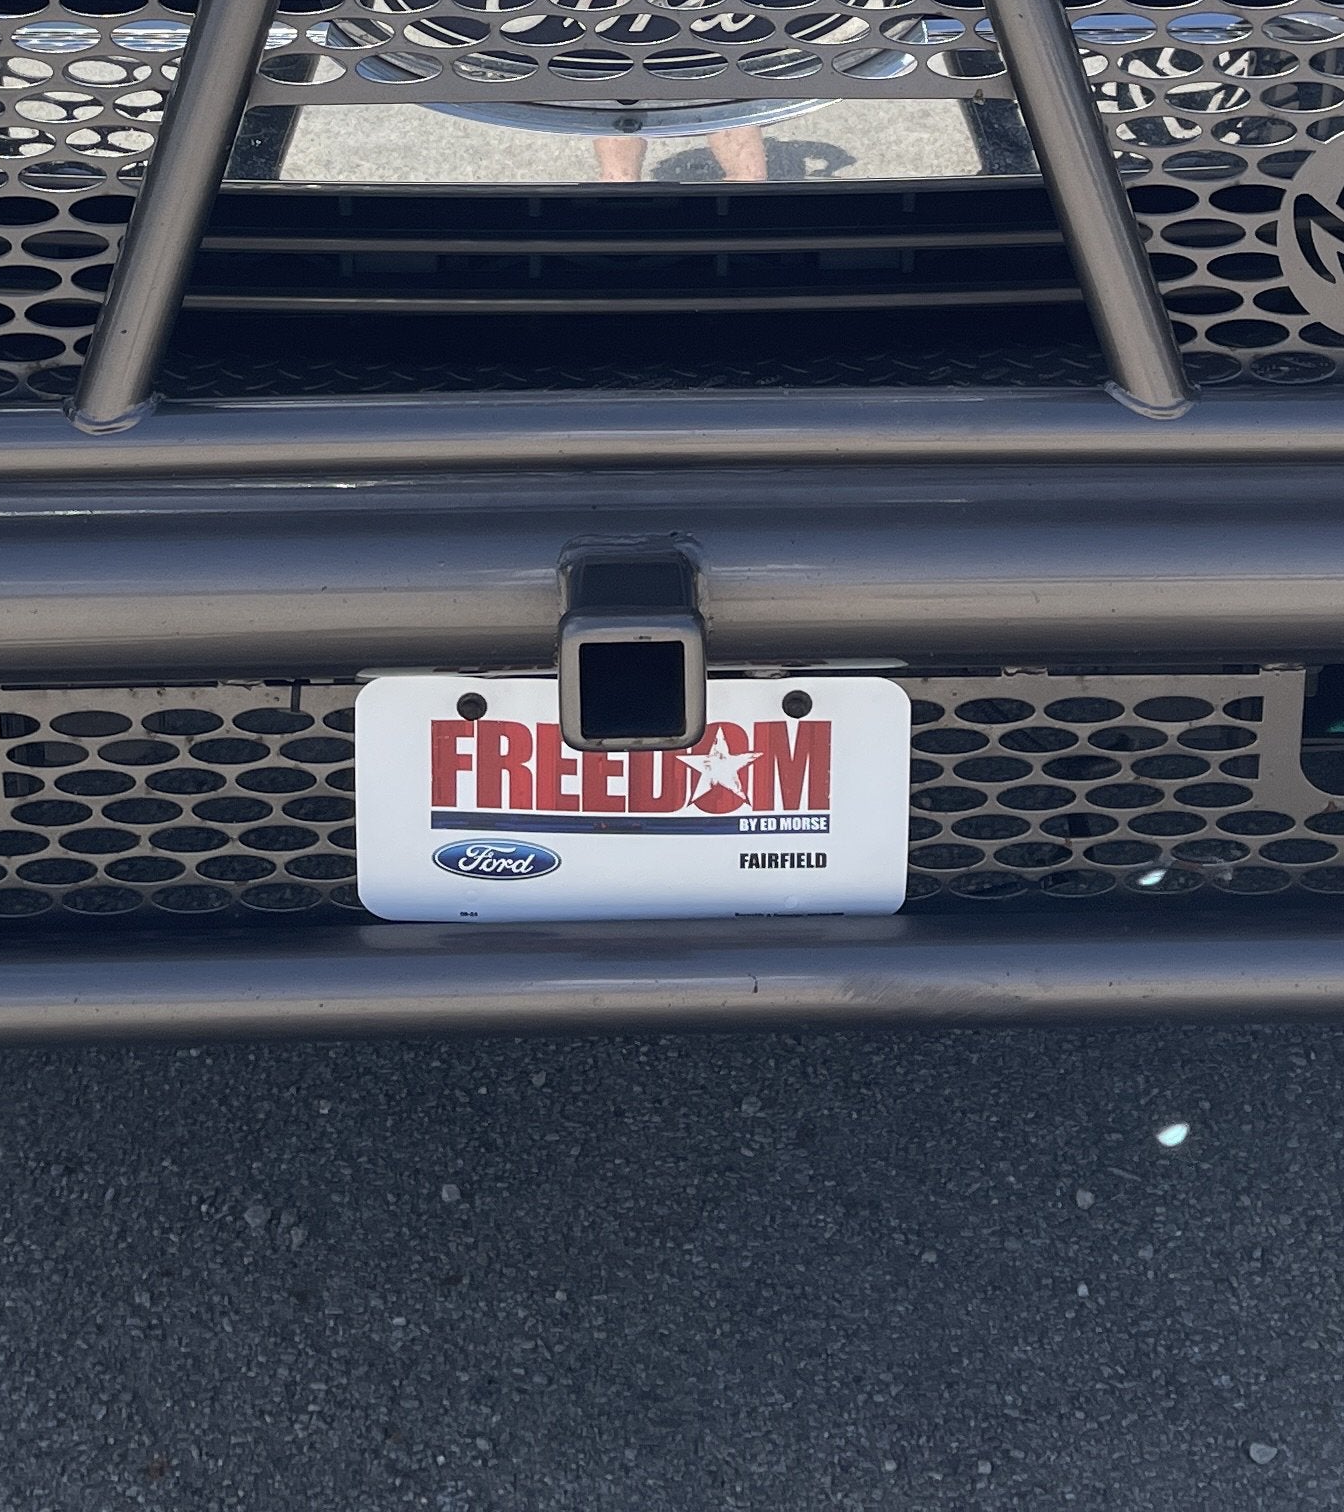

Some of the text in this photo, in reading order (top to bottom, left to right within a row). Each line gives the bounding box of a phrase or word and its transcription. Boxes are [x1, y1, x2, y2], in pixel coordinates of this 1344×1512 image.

[430, 719, 832, 813] FREEDOM
[739, 816, 828, 832] BY ED MORSE
[458, 843, 535, 875] Ford
[739, 852, 828, 869] FAIRFIELD
